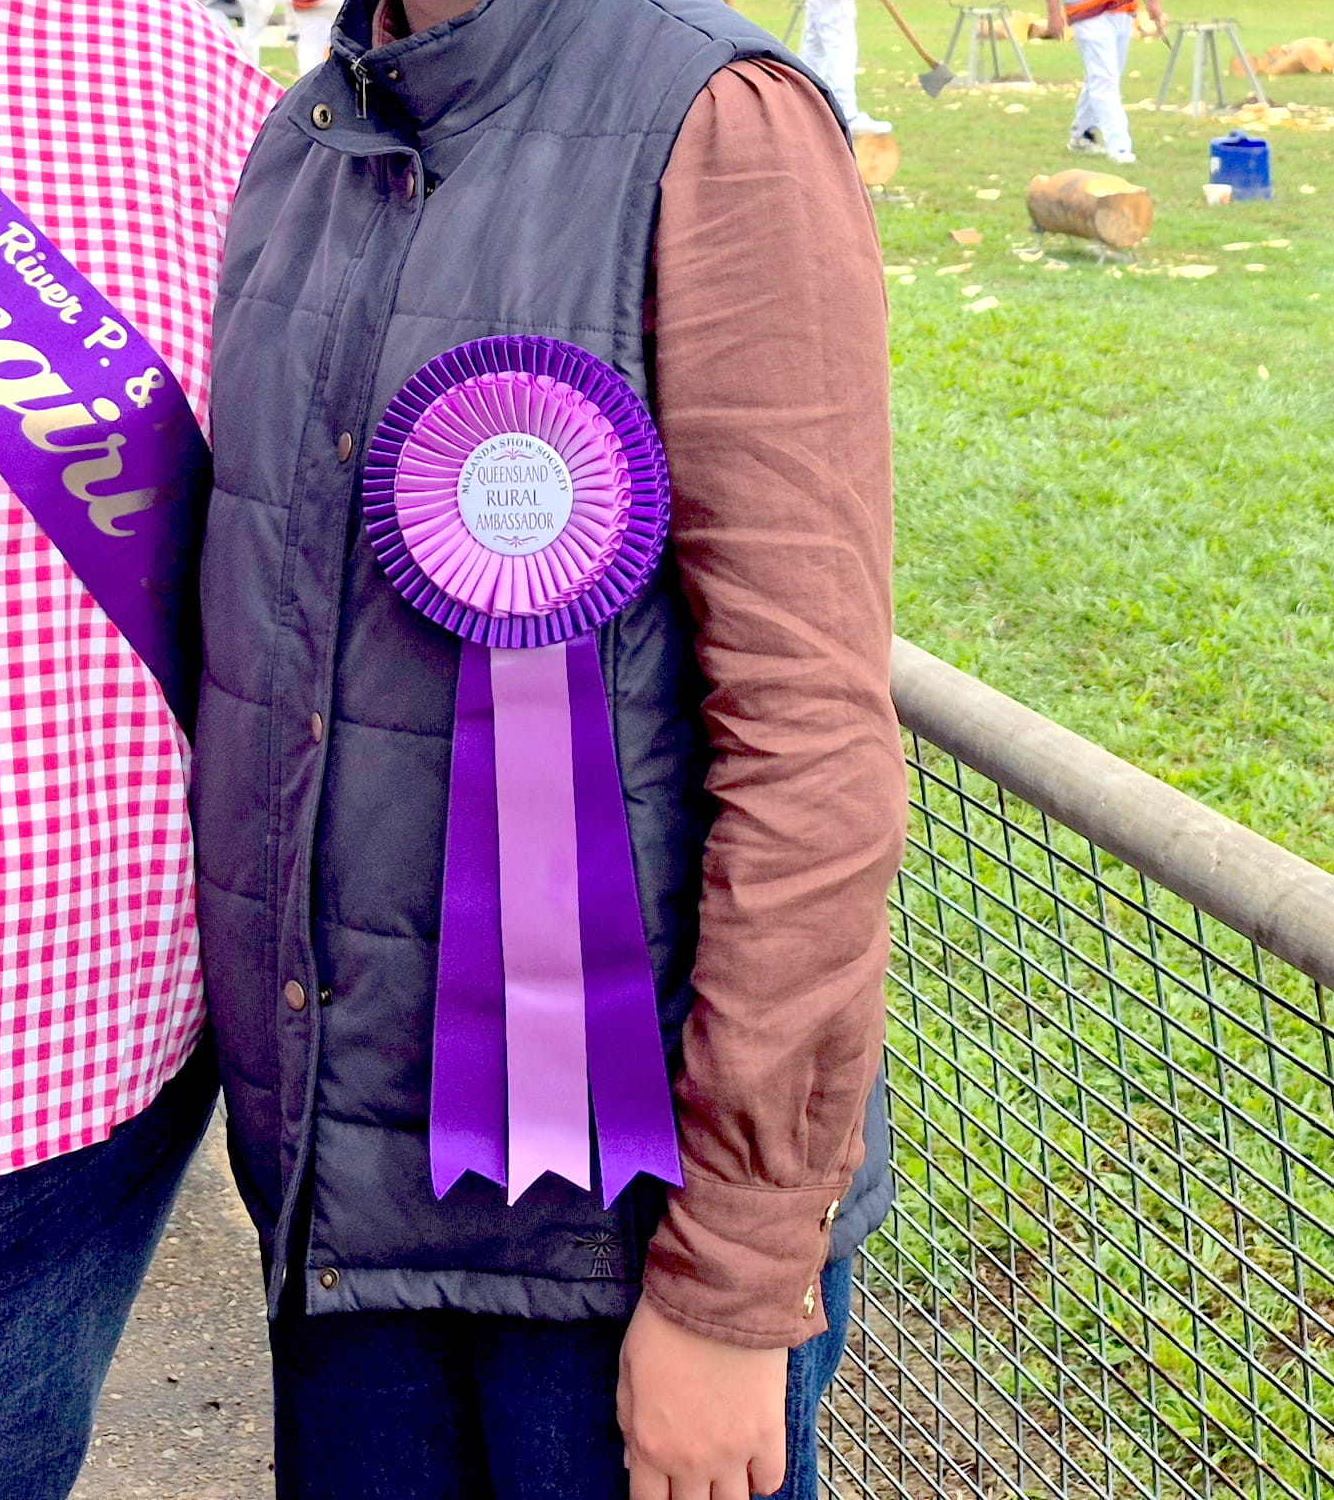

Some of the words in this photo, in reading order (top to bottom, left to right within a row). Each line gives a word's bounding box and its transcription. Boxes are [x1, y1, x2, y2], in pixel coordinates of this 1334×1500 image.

[83, 315, 128, 368] P.
[125, 366, 165, 409] &
[461, 443, 498, 495] MALANDA
[498, 437, 535, 449] SHOW
[535, 445, 569, 493] SOCIETY
[477, 465, 549, 486] QUEENSLAND
[486, 489, 542, 507] RURAL
[475, 512, 555, 531] AMBASSADOR
